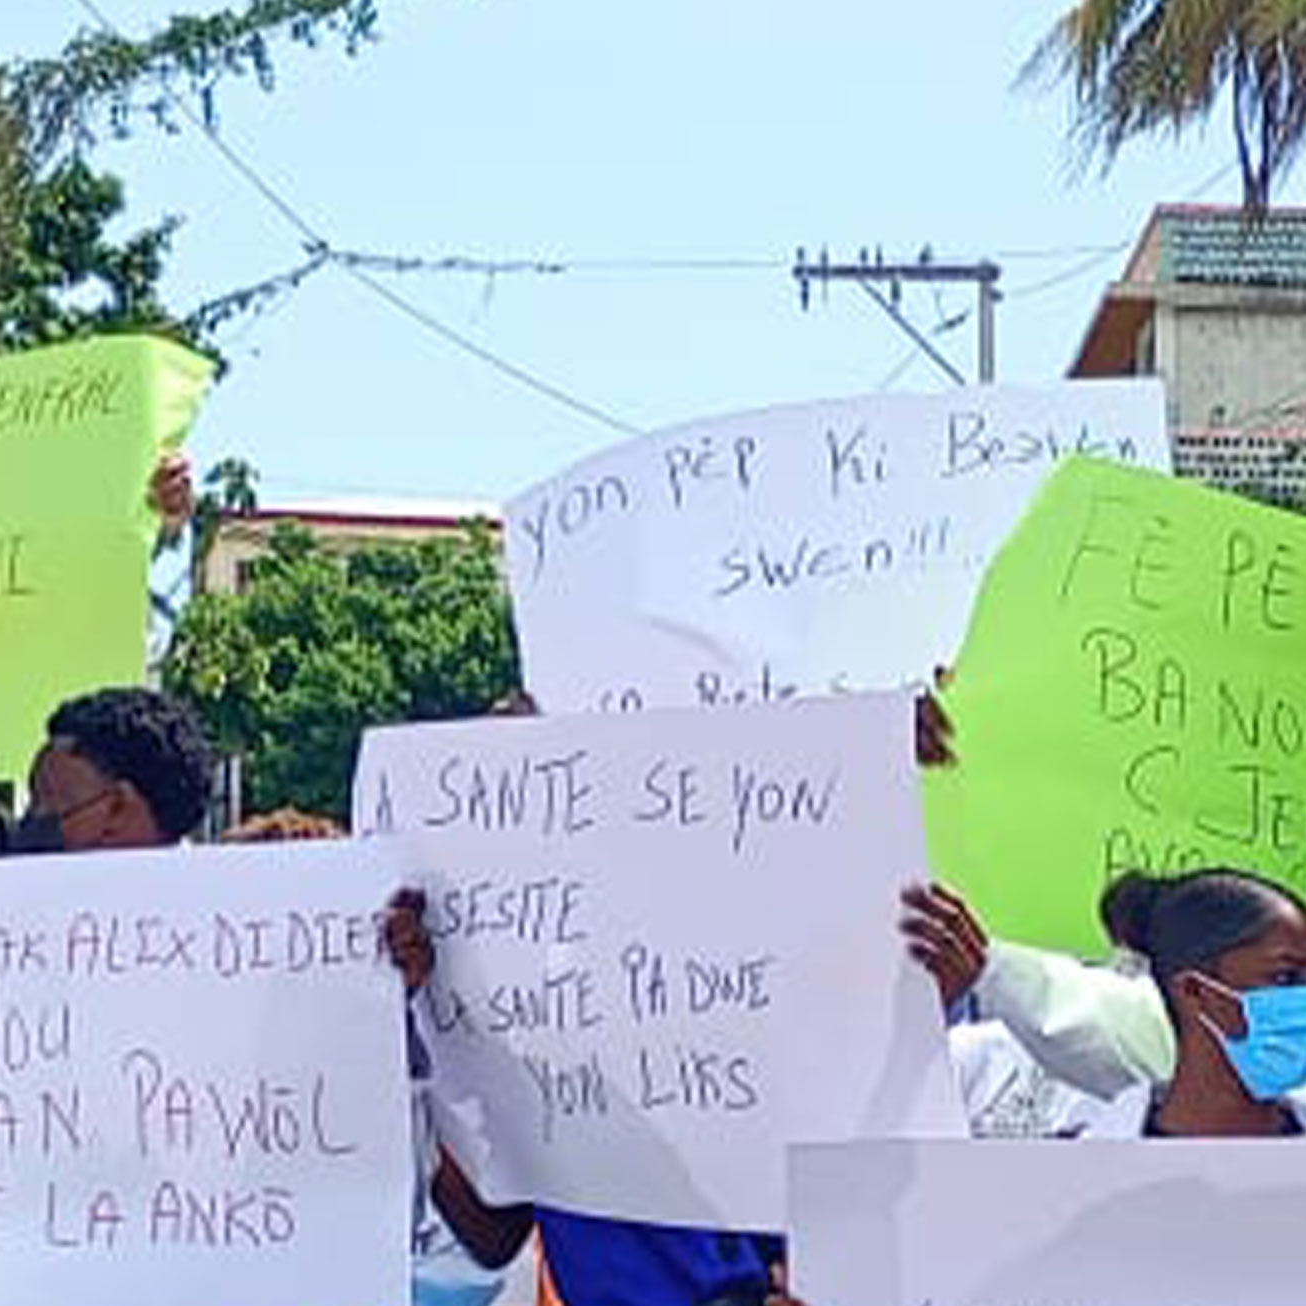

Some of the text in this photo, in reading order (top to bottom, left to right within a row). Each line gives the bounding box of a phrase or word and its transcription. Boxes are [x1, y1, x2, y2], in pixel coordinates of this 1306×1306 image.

[1081, 626, 1186, 733] BA
[425, 750, 595, 836] SANTE
[635, 759, 705, 824] SE
[733, 764, 837, 853] YON
[431, 876, 590, 944] SESITE
[620, 944, 669, 1024] PA
[46, 1182, 125, 1252] LA
